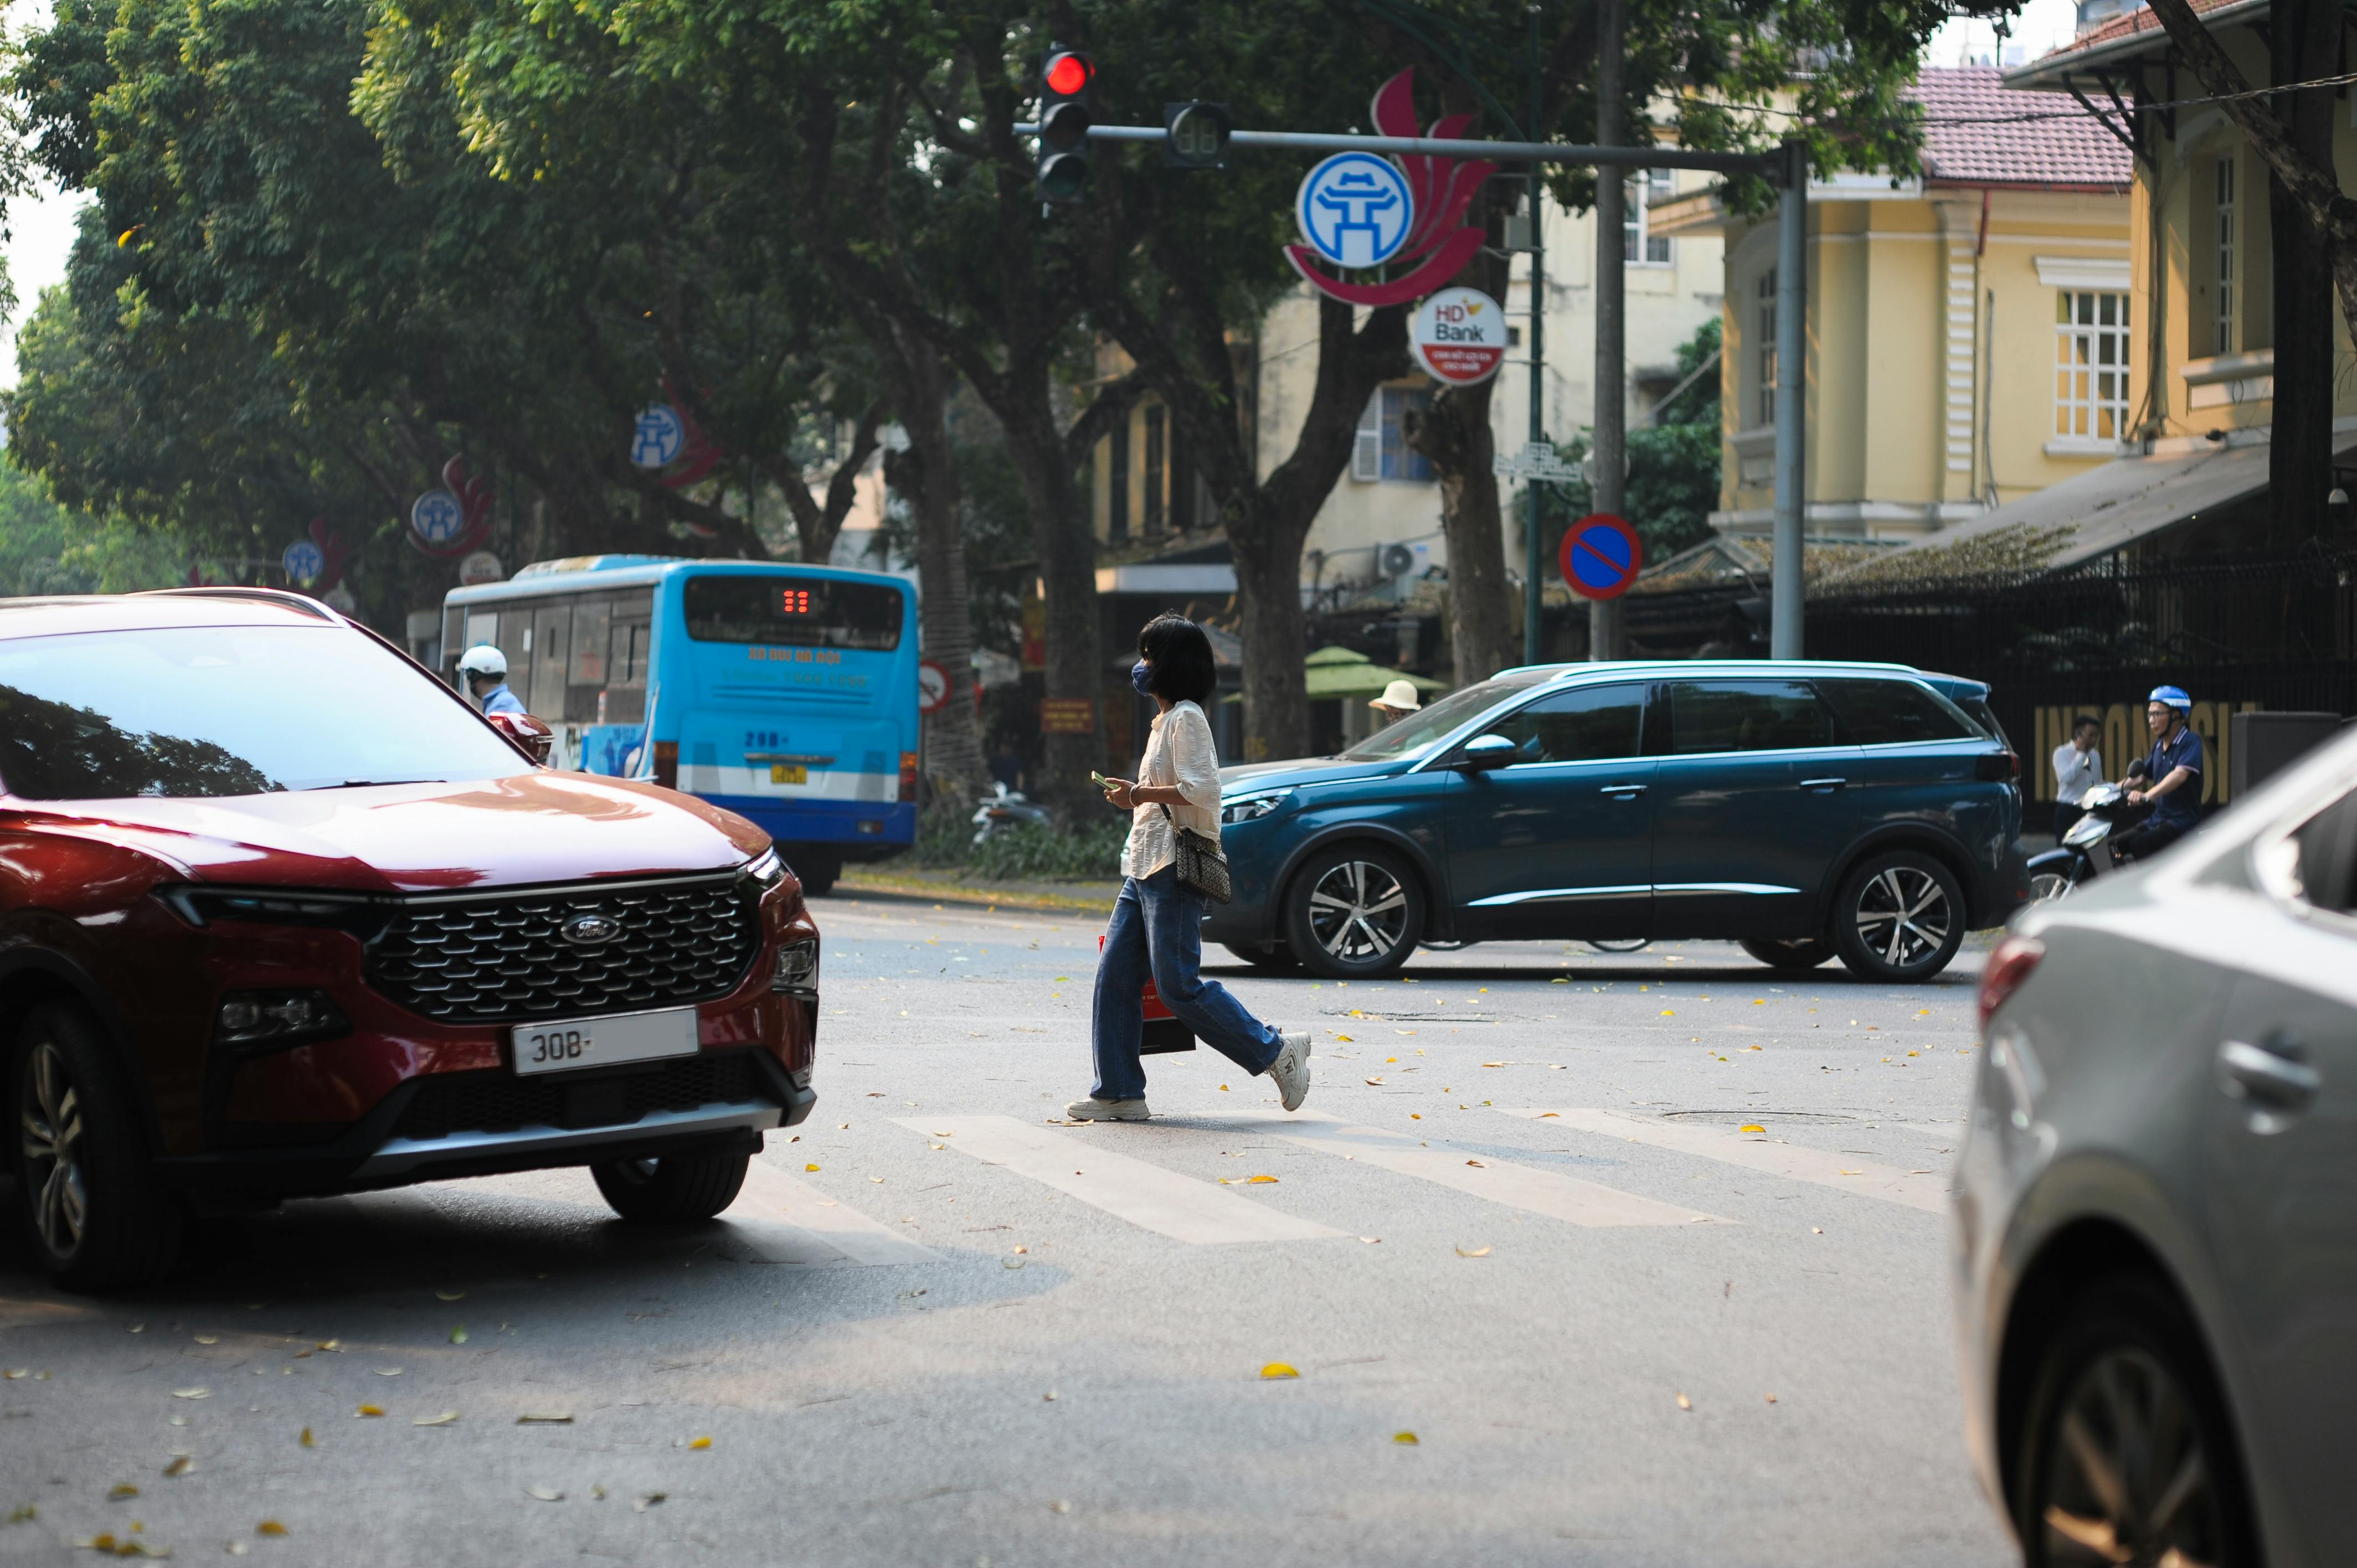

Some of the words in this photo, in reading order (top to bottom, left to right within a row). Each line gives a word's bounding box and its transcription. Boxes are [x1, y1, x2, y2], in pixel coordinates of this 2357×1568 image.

[1435, 305, 1464, 322] HD
[1435, 323, 1484, 342] Bank
[577, 920, 609, 937] Ford
